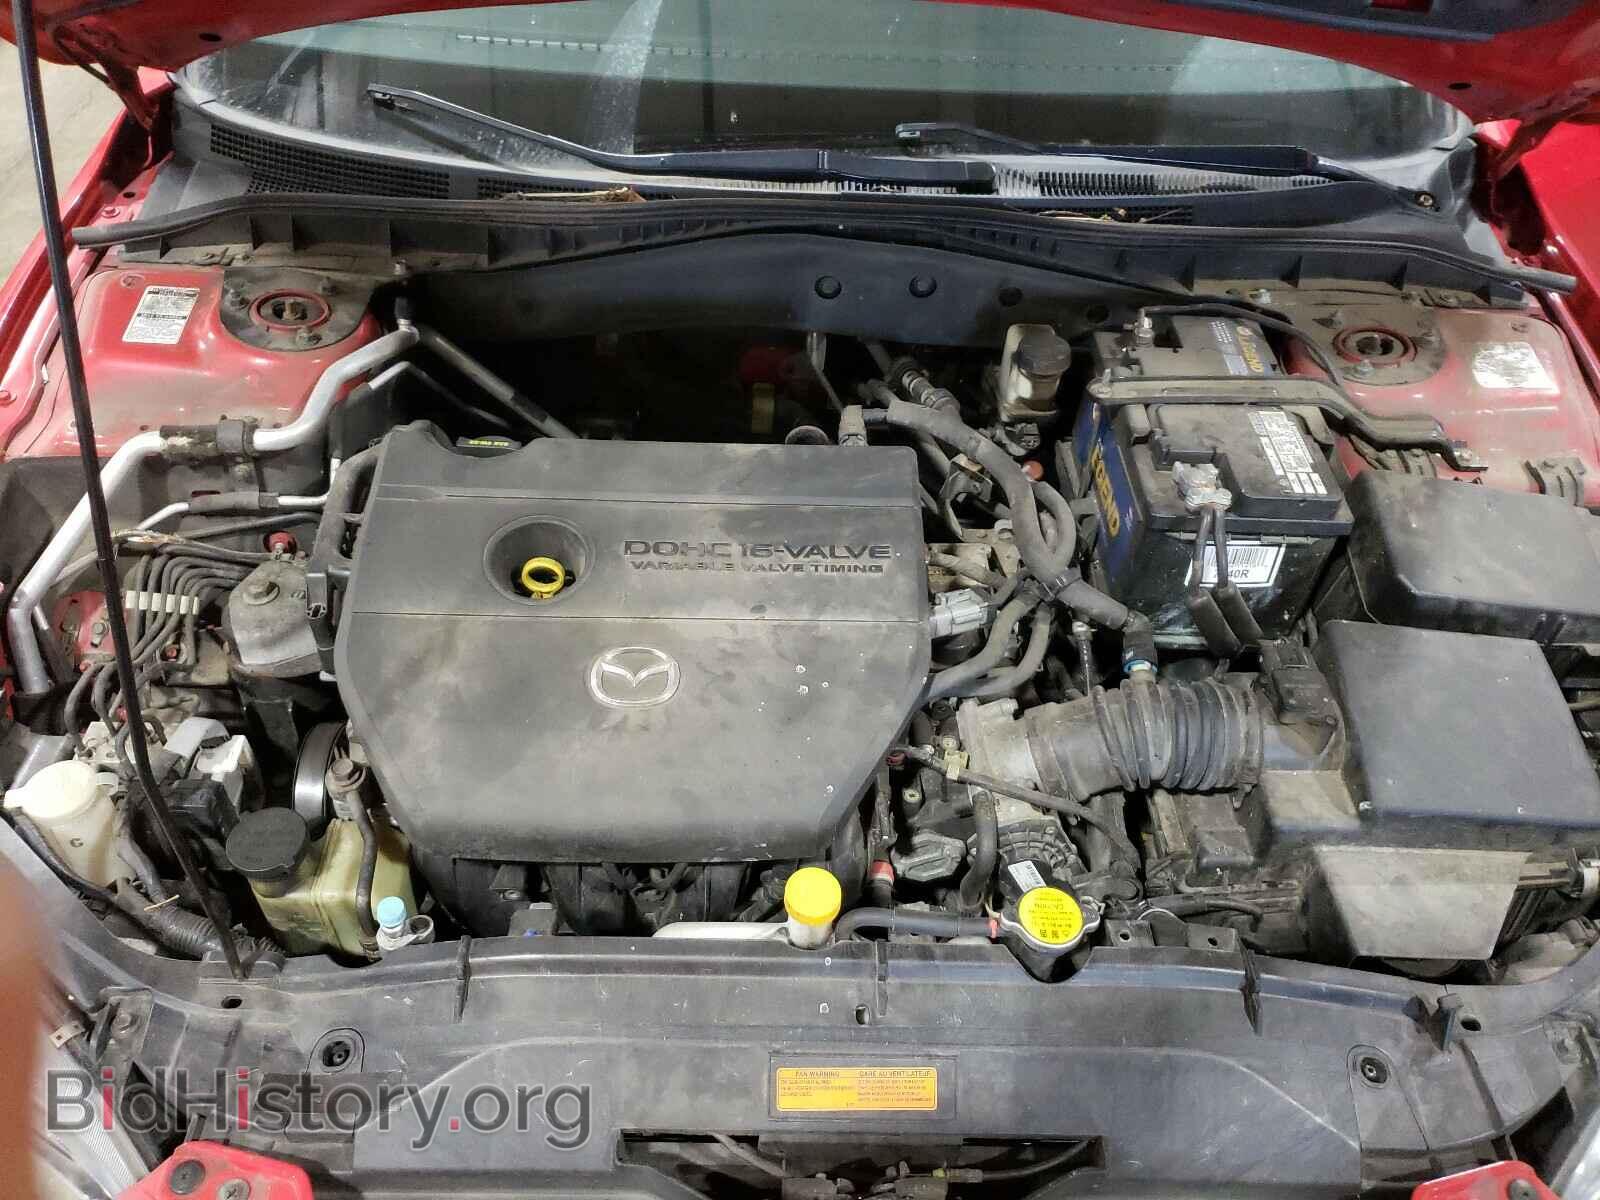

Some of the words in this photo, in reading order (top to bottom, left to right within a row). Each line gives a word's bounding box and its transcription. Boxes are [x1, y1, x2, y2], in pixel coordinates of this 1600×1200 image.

[624, 540, 733, 557] DOHC
[741, 543, 892, 560] 16-VALVE
[631, 560, 734, 572] VARIABLE
[746, 562, 804, 573] VALVE
[810, 563, 884, 574] TIMING
